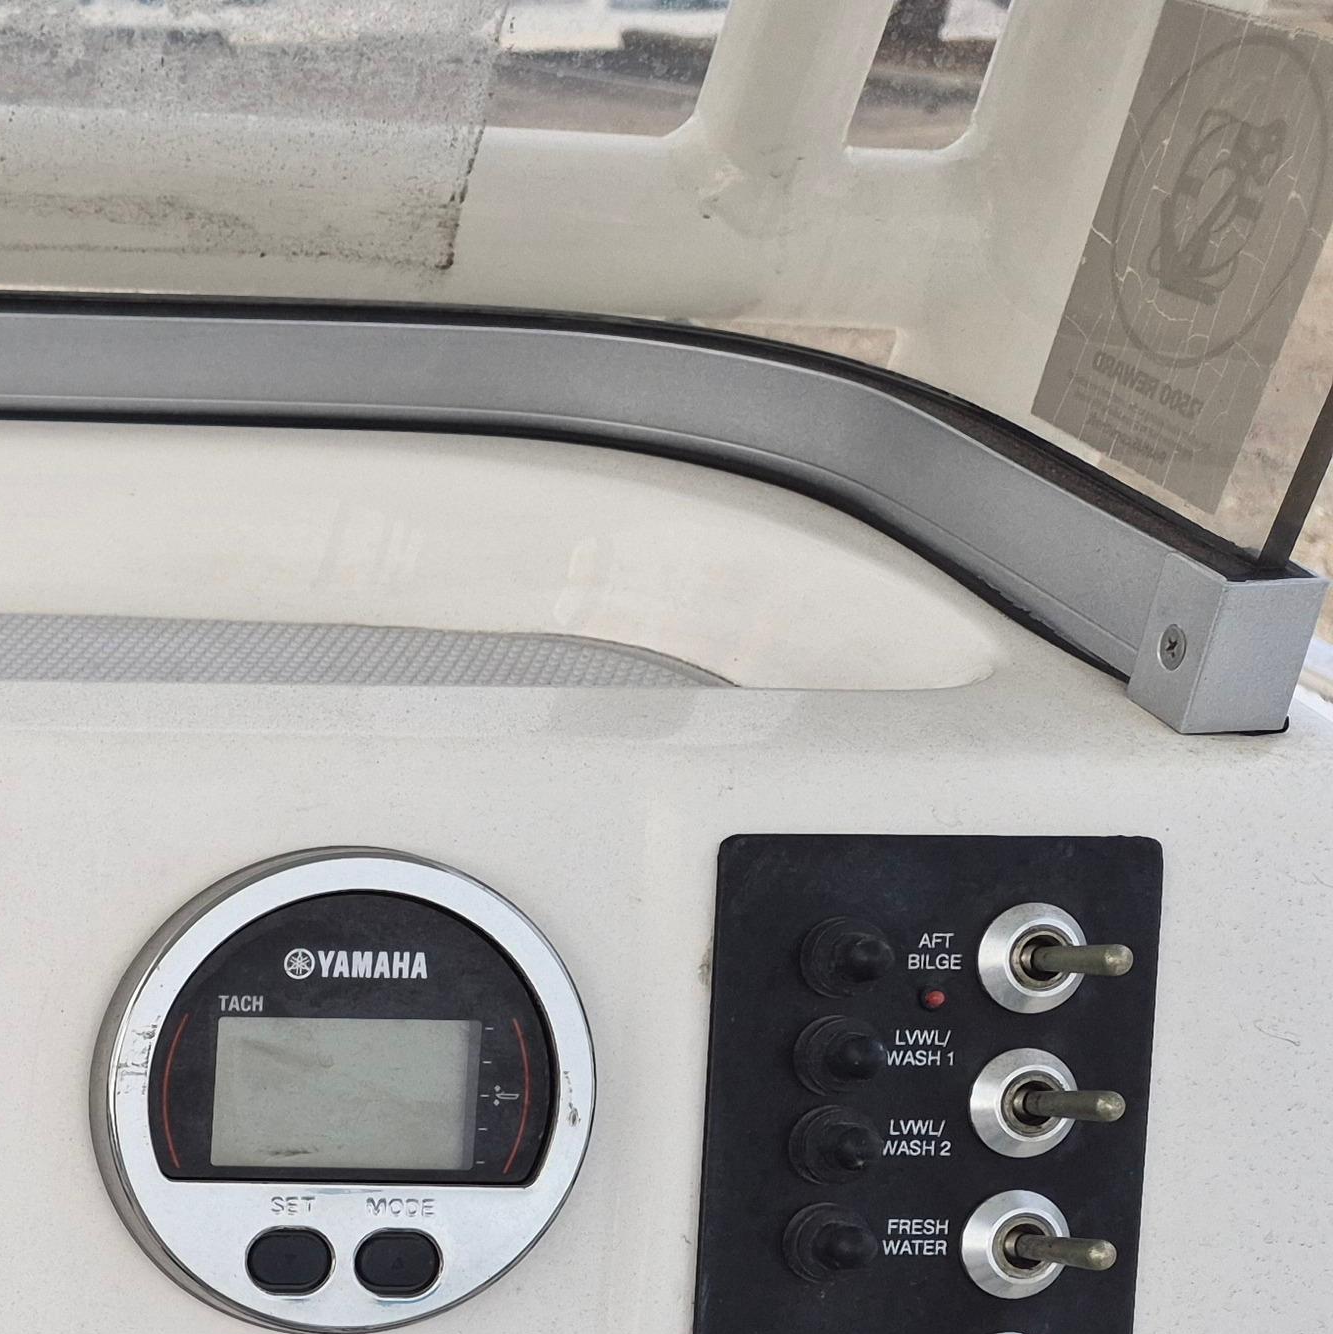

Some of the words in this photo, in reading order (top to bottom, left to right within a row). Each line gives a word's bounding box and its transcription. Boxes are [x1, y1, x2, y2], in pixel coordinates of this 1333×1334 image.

[918, 933, 954, 949] AFT
[318, 950, 428, 979] YAMAHA
[907, 953, 962, 970] BILGE
[219, 995, 264, 1012] TACH
[895, 1029, 951, 1047] LVWL/
[887, 1050, 941, 1066] WASH
[947, 1051, 954, 1066] 1
[890, 1119, 946, 1137] LVWL/
[940, 1141, 951, 1156] 2
[270, 1196, 316, 1215] SET
[366, 1197, 435, 1217] MODE
[887, 1219, 949, 1235] FRESH
[882, 1240, 948, 1255] WATER
